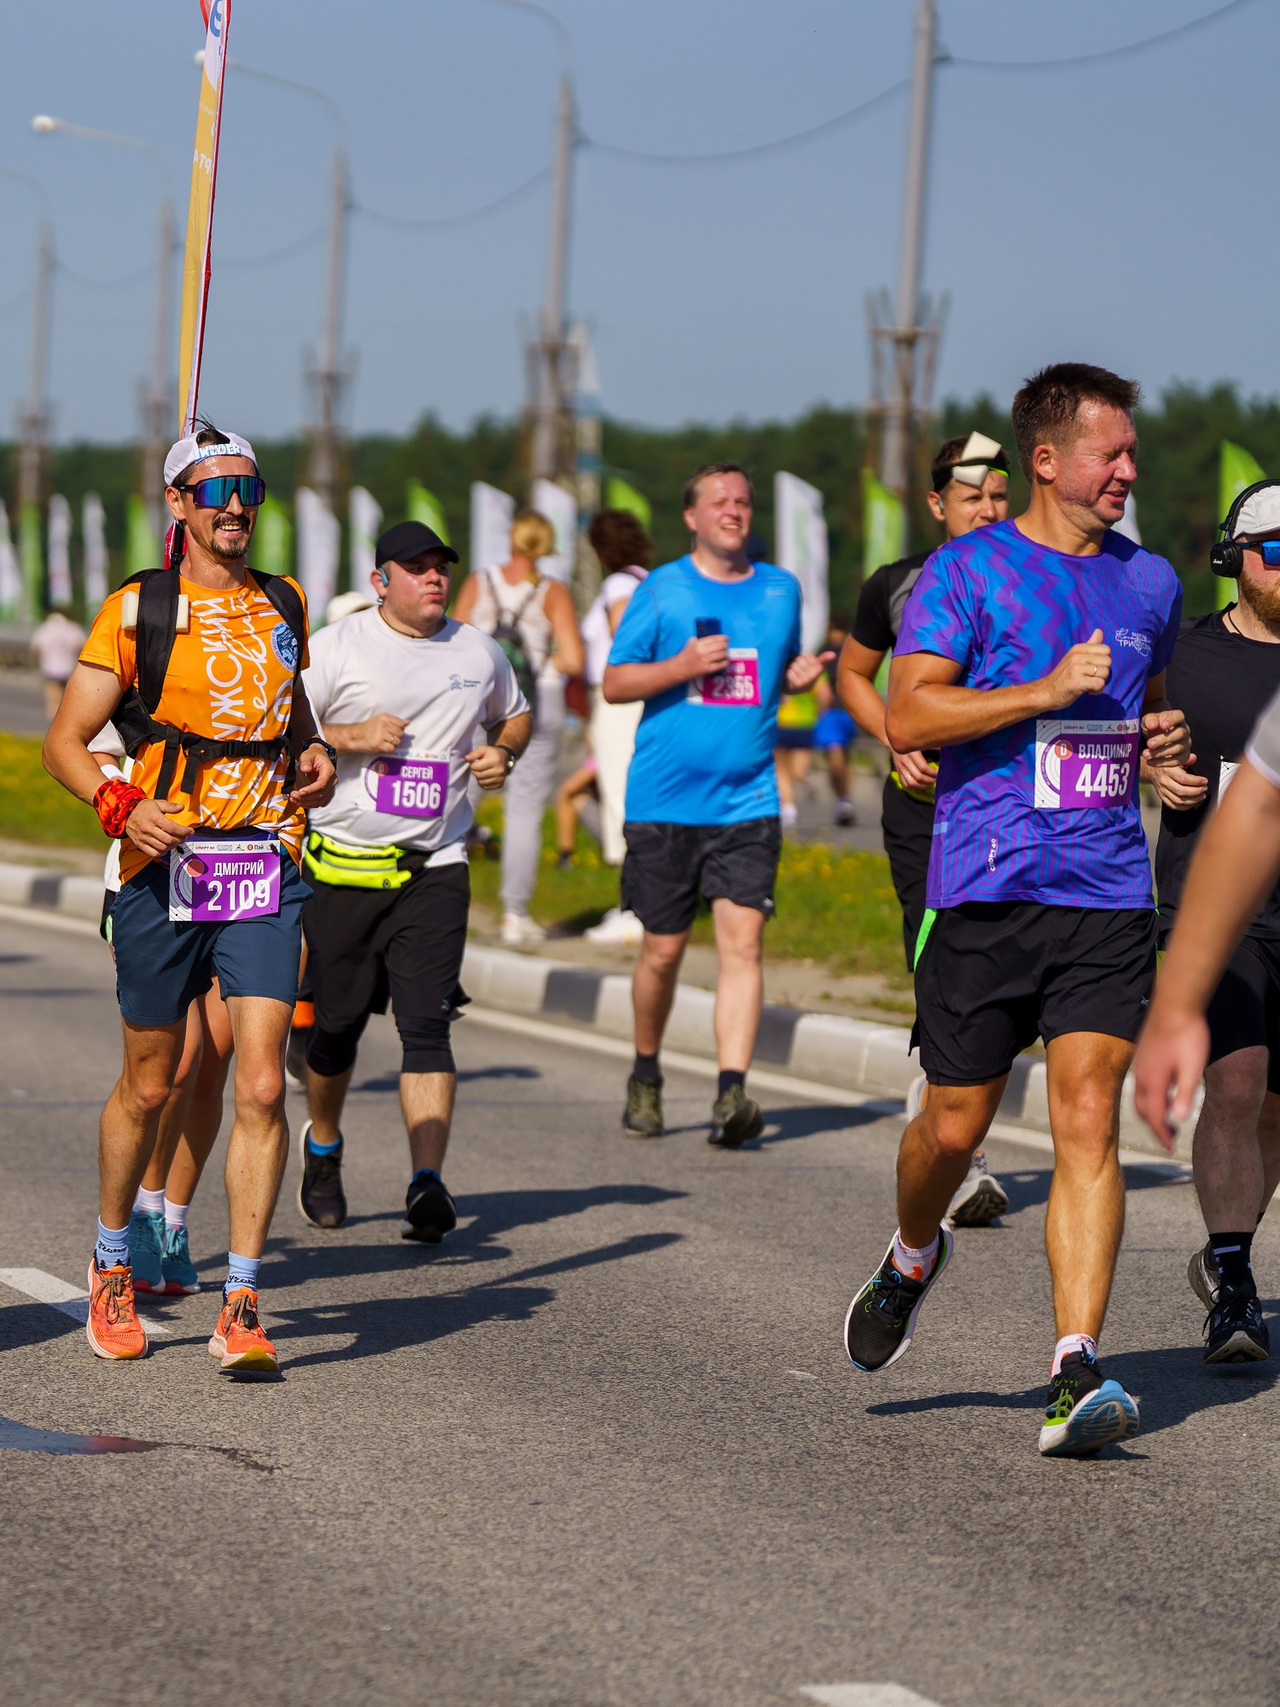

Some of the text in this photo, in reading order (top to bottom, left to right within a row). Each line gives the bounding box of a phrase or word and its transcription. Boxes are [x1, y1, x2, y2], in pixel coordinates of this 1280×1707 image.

[190, 597, 246, 800] КАУЖСКИЙ
[1078, 743, 1132, 760] ВЛАДИМИР
[401, 765, 433, 779] СЕРГЕЙ
[1075, 763, 1130, 797] 4453
[392, 780, 441, 810] 1506
[213, 860, 265, 877] ДМИТРИЙ
[207, 879, 271, 911] 2109
